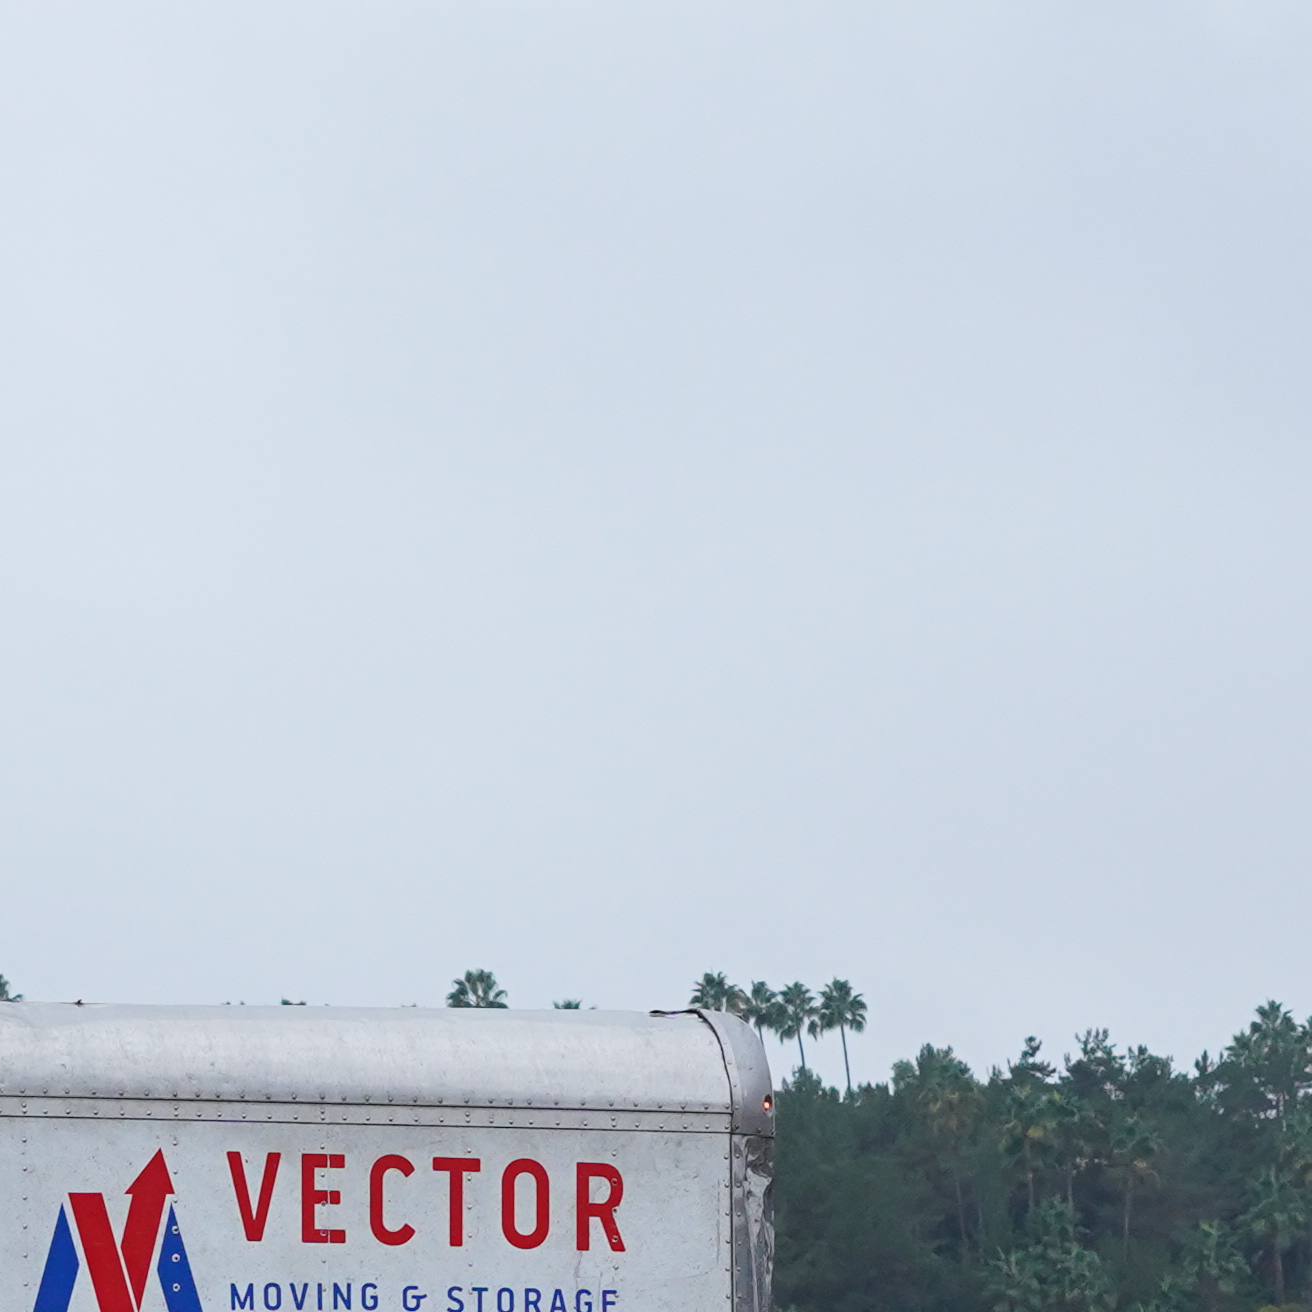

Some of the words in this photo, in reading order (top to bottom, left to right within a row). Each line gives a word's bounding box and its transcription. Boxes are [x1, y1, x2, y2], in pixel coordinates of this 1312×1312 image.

[226, 1150, 626, 1253] VECTOR
[229, 1281, 379, 1312] MOVING
[401, 1285, 428, 1312] &
